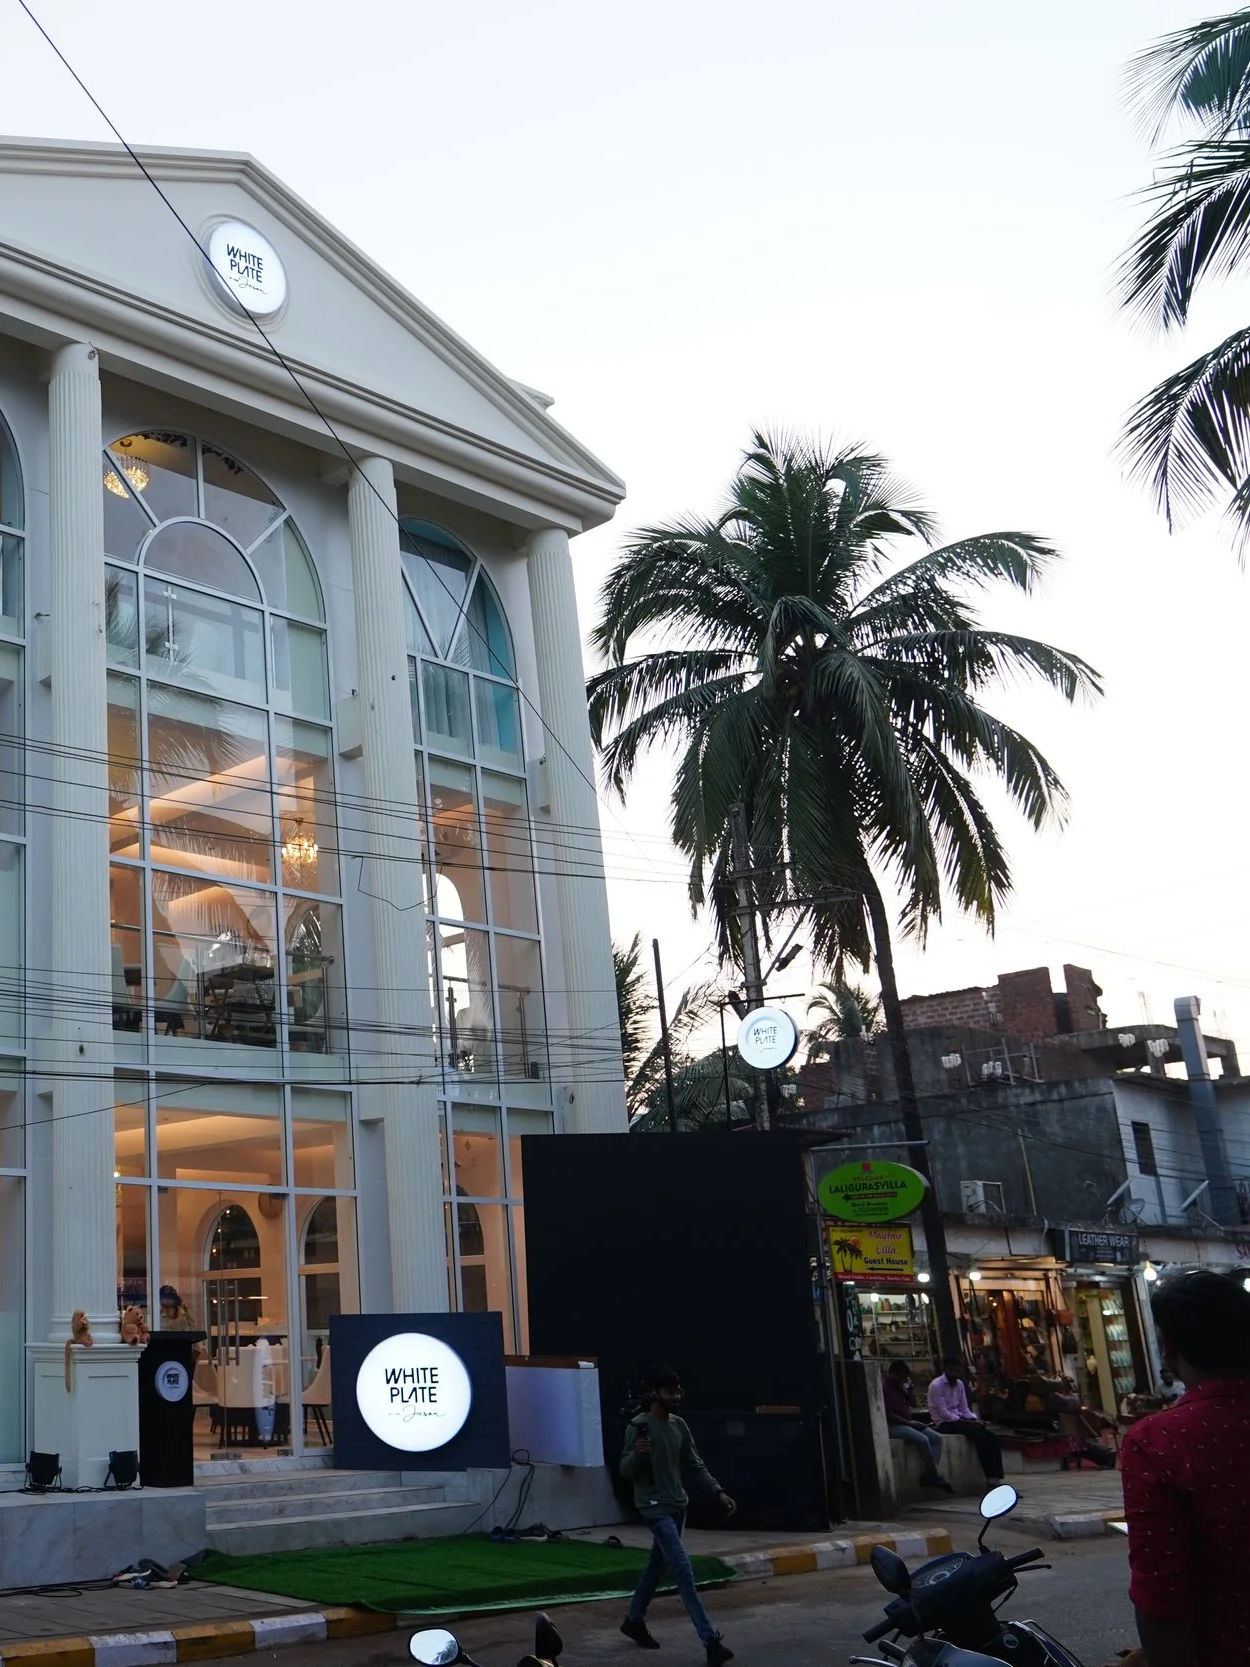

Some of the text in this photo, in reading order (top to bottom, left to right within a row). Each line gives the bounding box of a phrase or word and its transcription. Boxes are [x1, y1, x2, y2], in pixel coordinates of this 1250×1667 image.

[226, 244, 264, 270] WHITE
[230, 259, 262, 283] PLATE
[754, 1026, 778, 1036] WHITE
[756, 1036, 776, 1044] PLATE
[829, 1180, 907, 1194] LALIGURASVILLA
[868, 1231, 902, 1242] Mayfair
[1078, 1234, 1130, 1248] LEATHER WEAR
[876, 1246, 897, 1255] Villa
[384, 1367, 439, 1384] WHITE
[390, 1386, 438, 1404] PLATE
[402, 1404, 446, 1422] Jason
